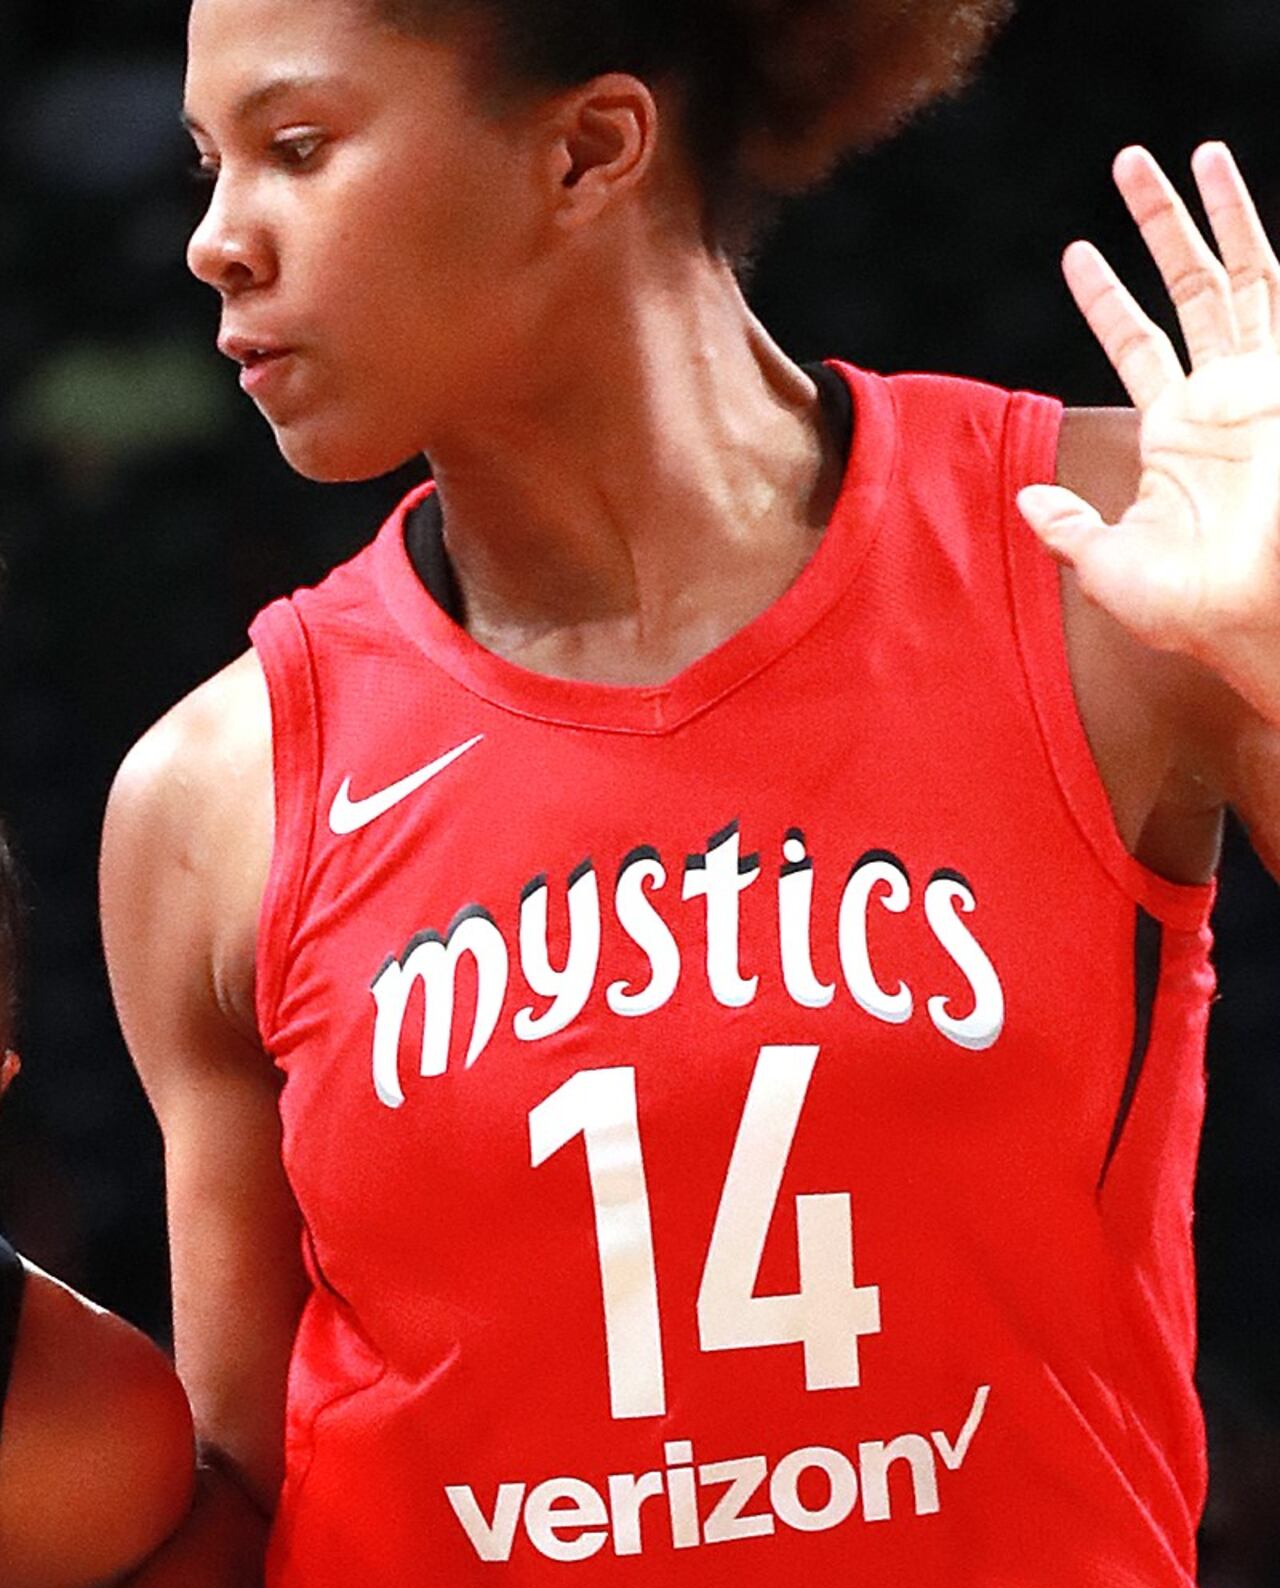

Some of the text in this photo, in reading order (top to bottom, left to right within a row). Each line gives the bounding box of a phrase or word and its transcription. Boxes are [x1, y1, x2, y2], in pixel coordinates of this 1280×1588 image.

[370, 818, 1006, 1109] mystics
[527, 1043, 882, 1421] 14
[444, 1431, 941, 1563] verizon
